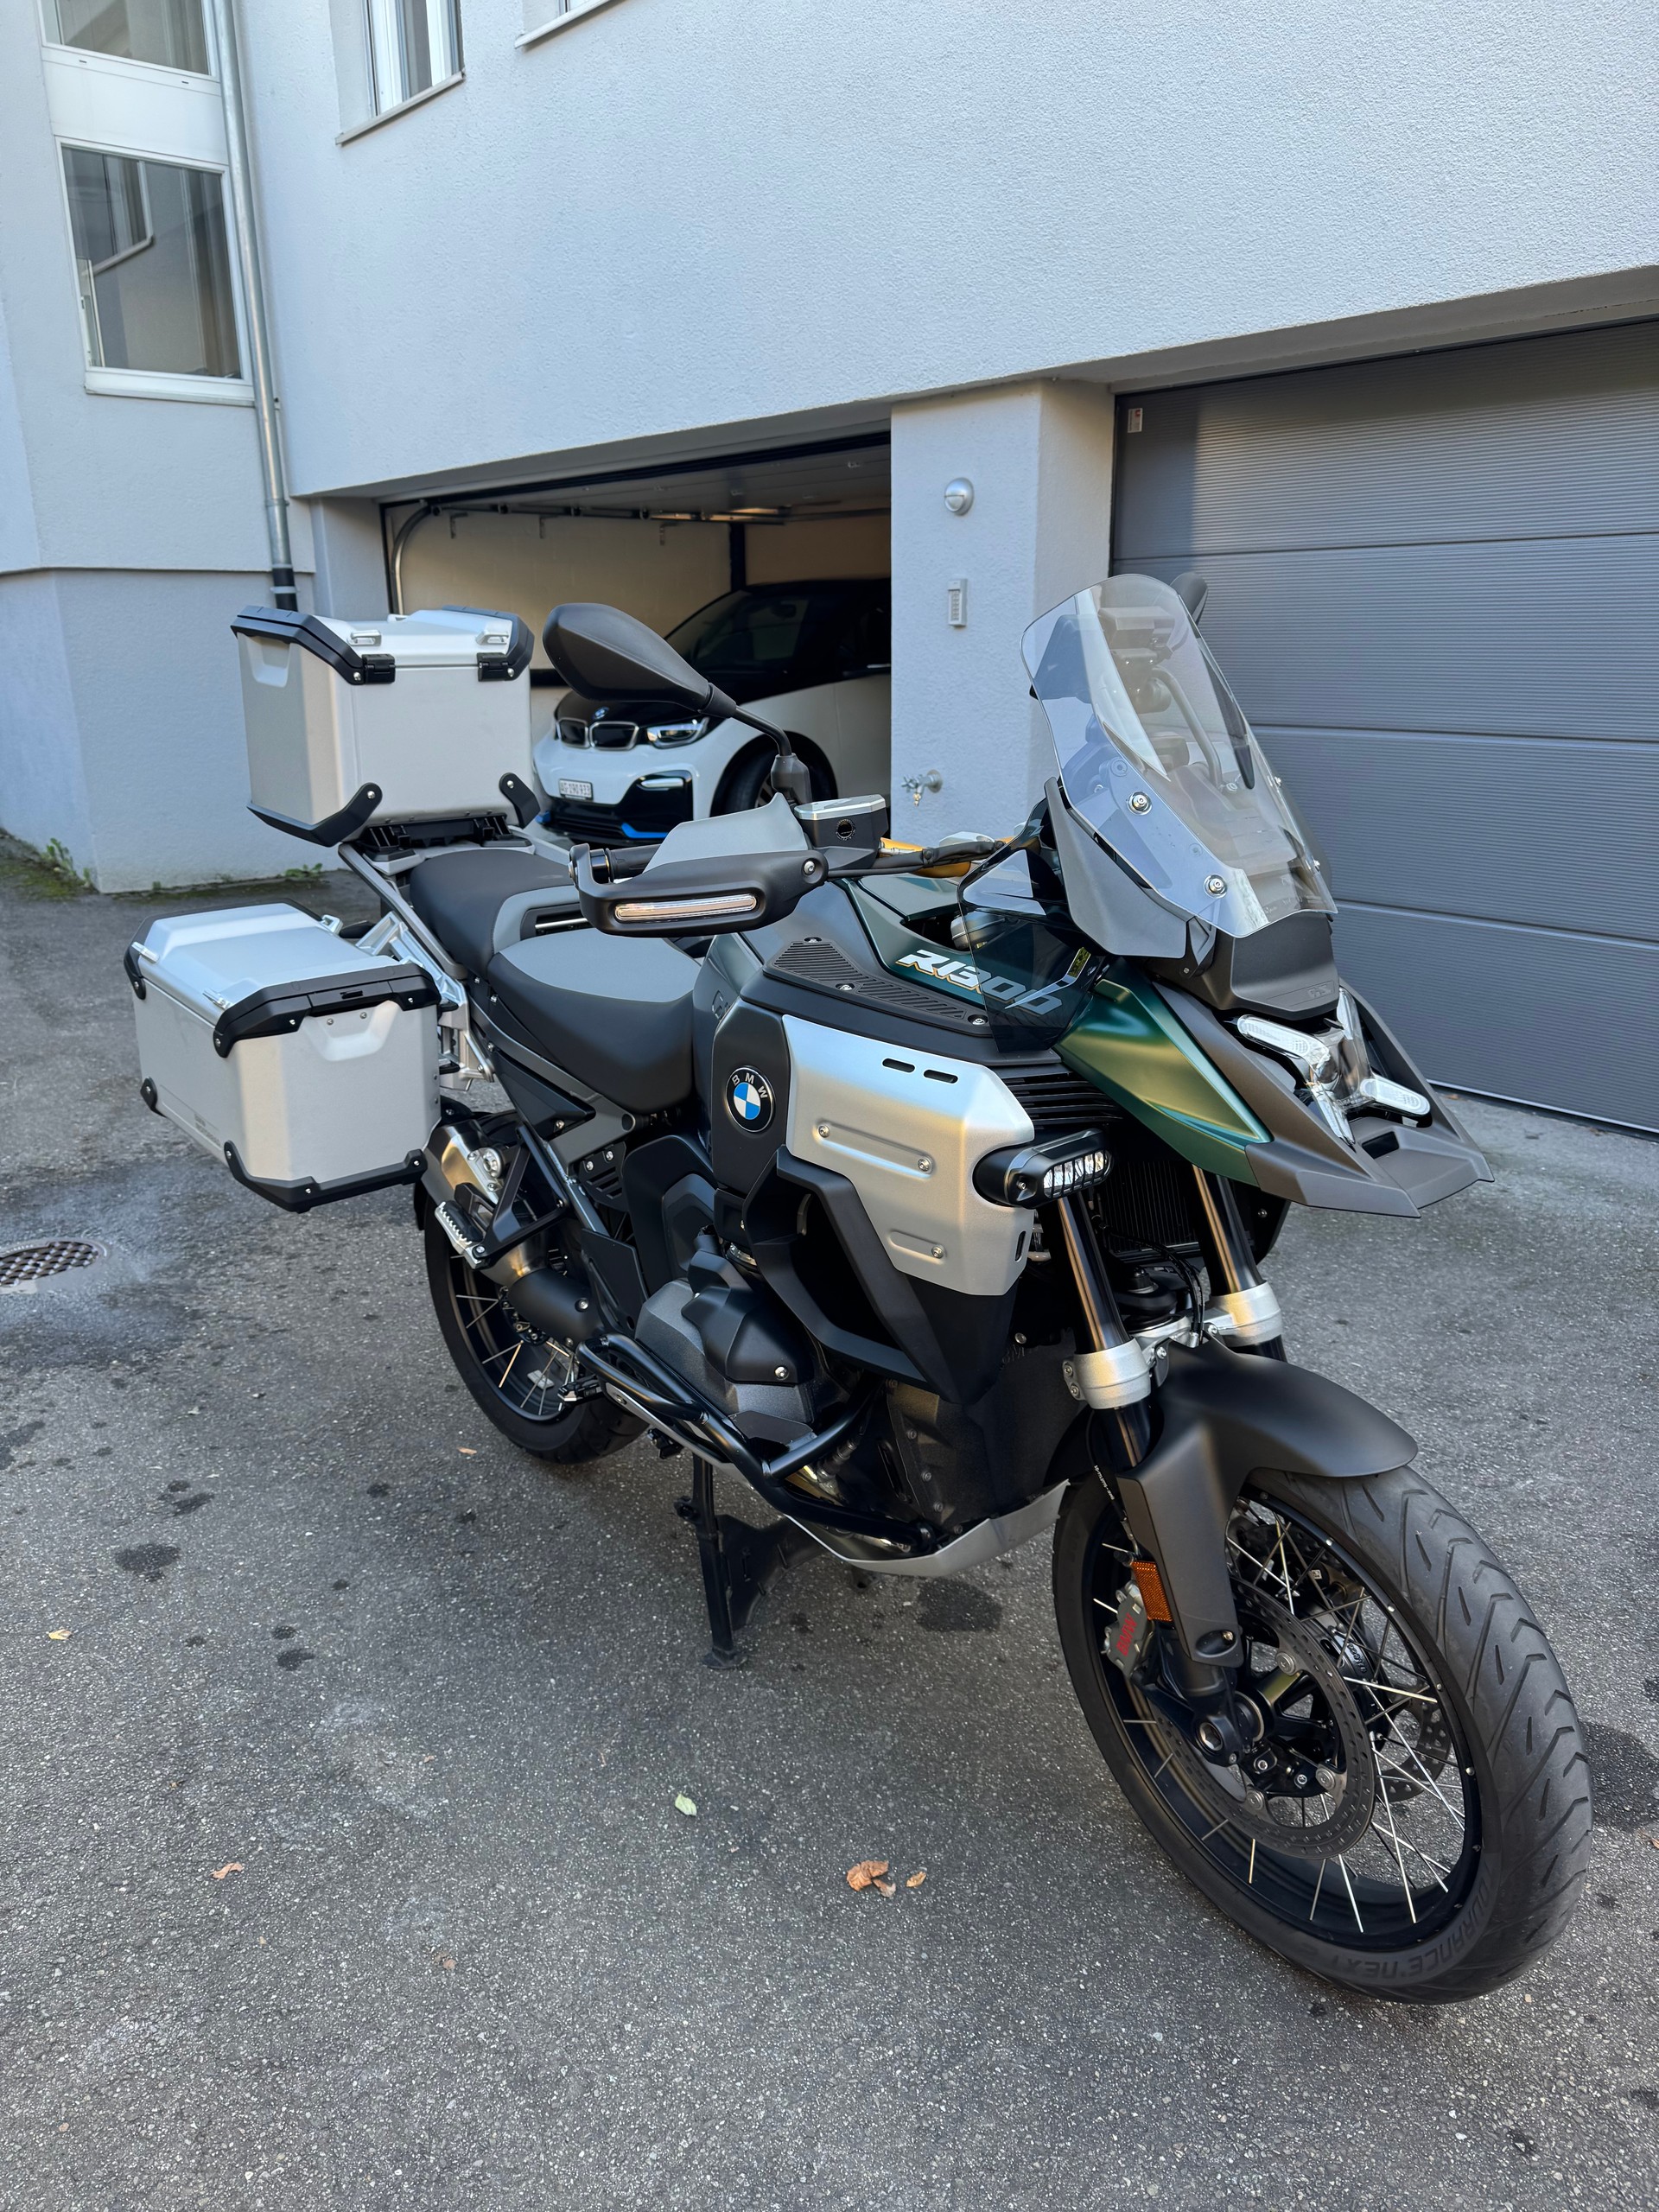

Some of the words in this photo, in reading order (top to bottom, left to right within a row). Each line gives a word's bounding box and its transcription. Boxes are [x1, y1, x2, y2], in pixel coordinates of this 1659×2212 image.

[895, 949, 1063, 1015] R1300
[731, 1072, 769, 1099] BMW
[1116, 1611, 1138, 1656] BMW
